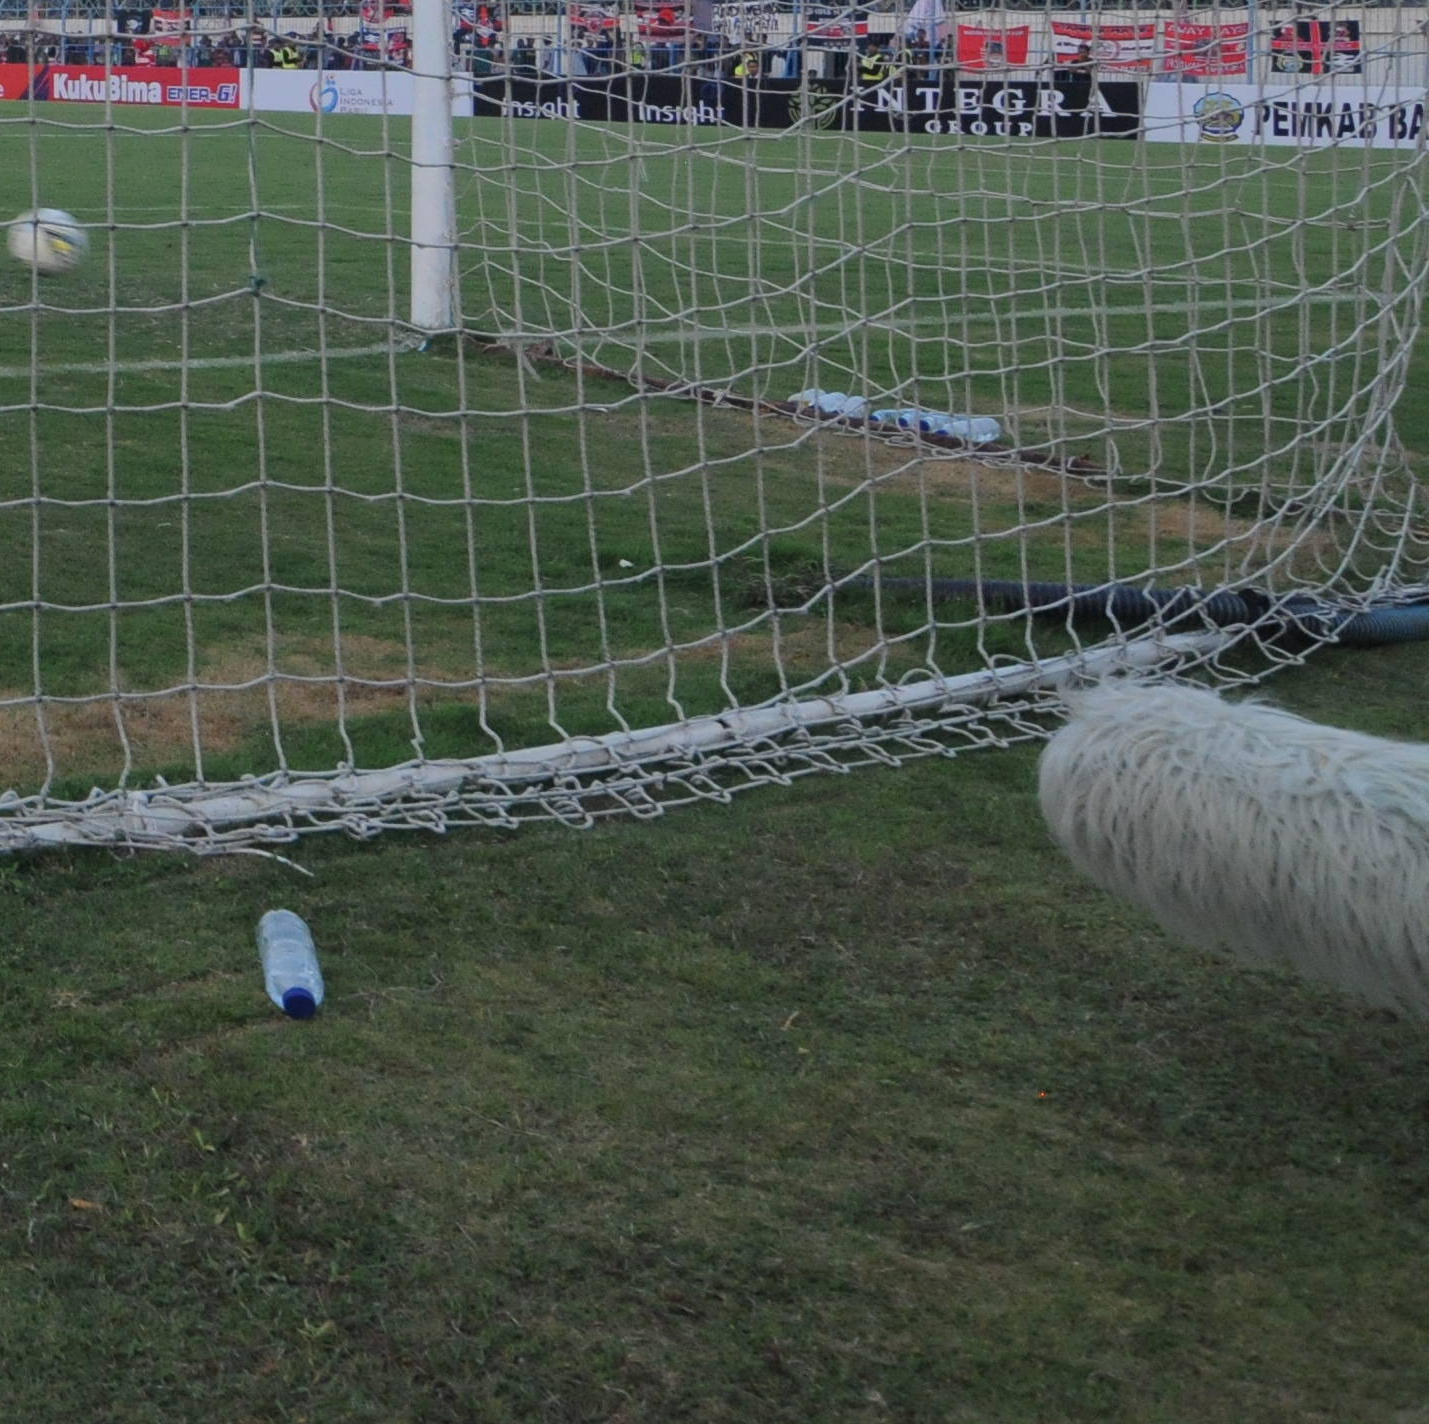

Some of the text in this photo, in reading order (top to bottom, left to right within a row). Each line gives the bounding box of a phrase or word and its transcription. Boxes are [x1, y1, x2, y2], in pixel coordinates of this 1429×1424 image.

[52, 73, 162, 104] KukuBima
[340, 97, 393, 107] INDONESA
[849, 85, 1118, 118] INTEGRA
[924, 119, 1034, 137] GROUP
[1255, 100, 1379, 141] PEMKAB
